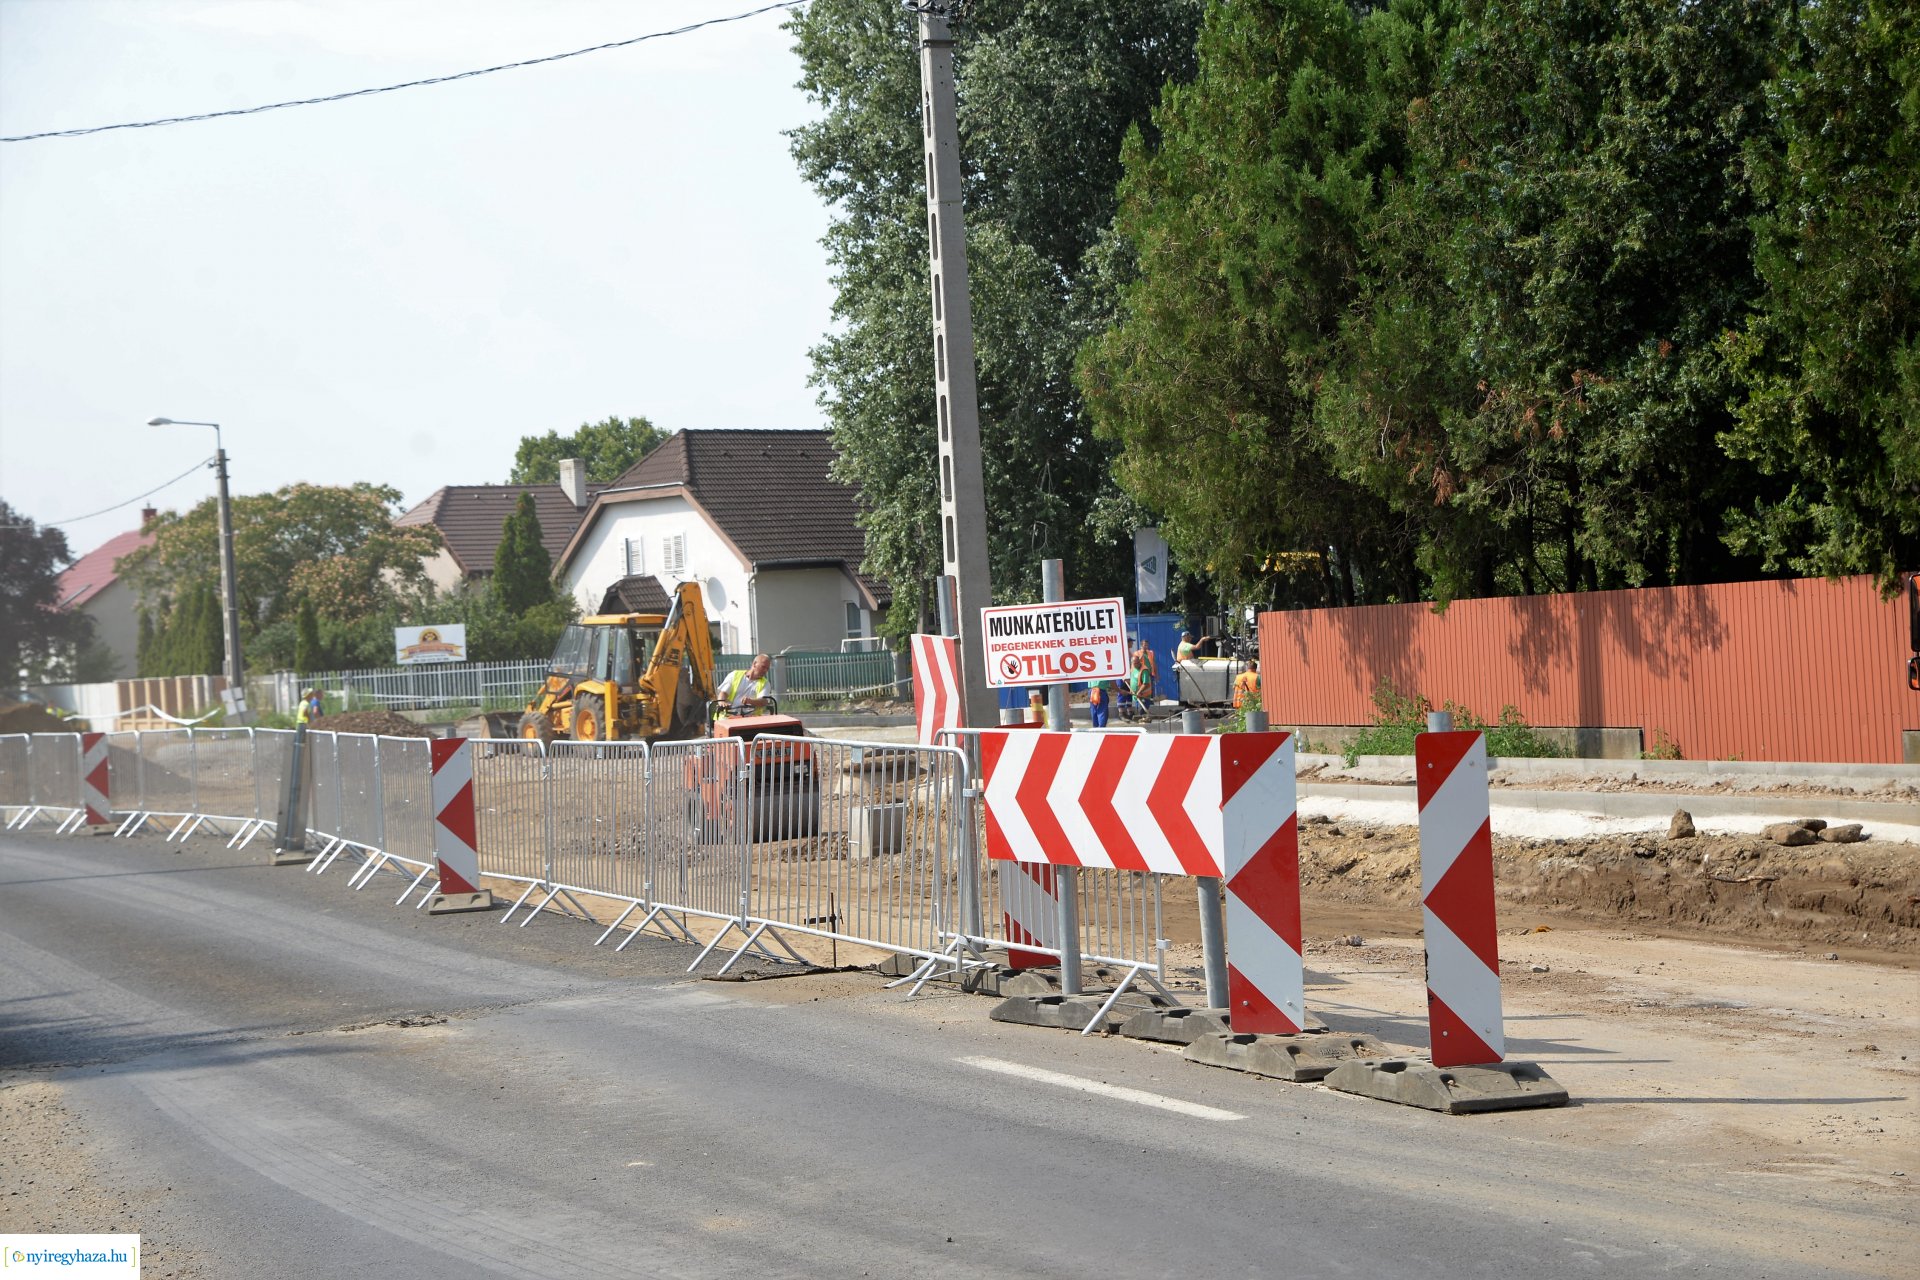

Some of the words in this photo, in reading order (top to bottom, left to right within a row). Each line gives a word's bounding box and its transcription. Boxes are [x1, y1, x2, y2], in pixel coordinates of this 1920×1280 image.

[989, 607, 1115, 637] MUNKATERÜLET
[991, 639, 1065, 652] IDEGENEKNEK
[1069, 634, 1118, 647] BELÉPNI
[1022, 651, 1097, 676] TILOS
